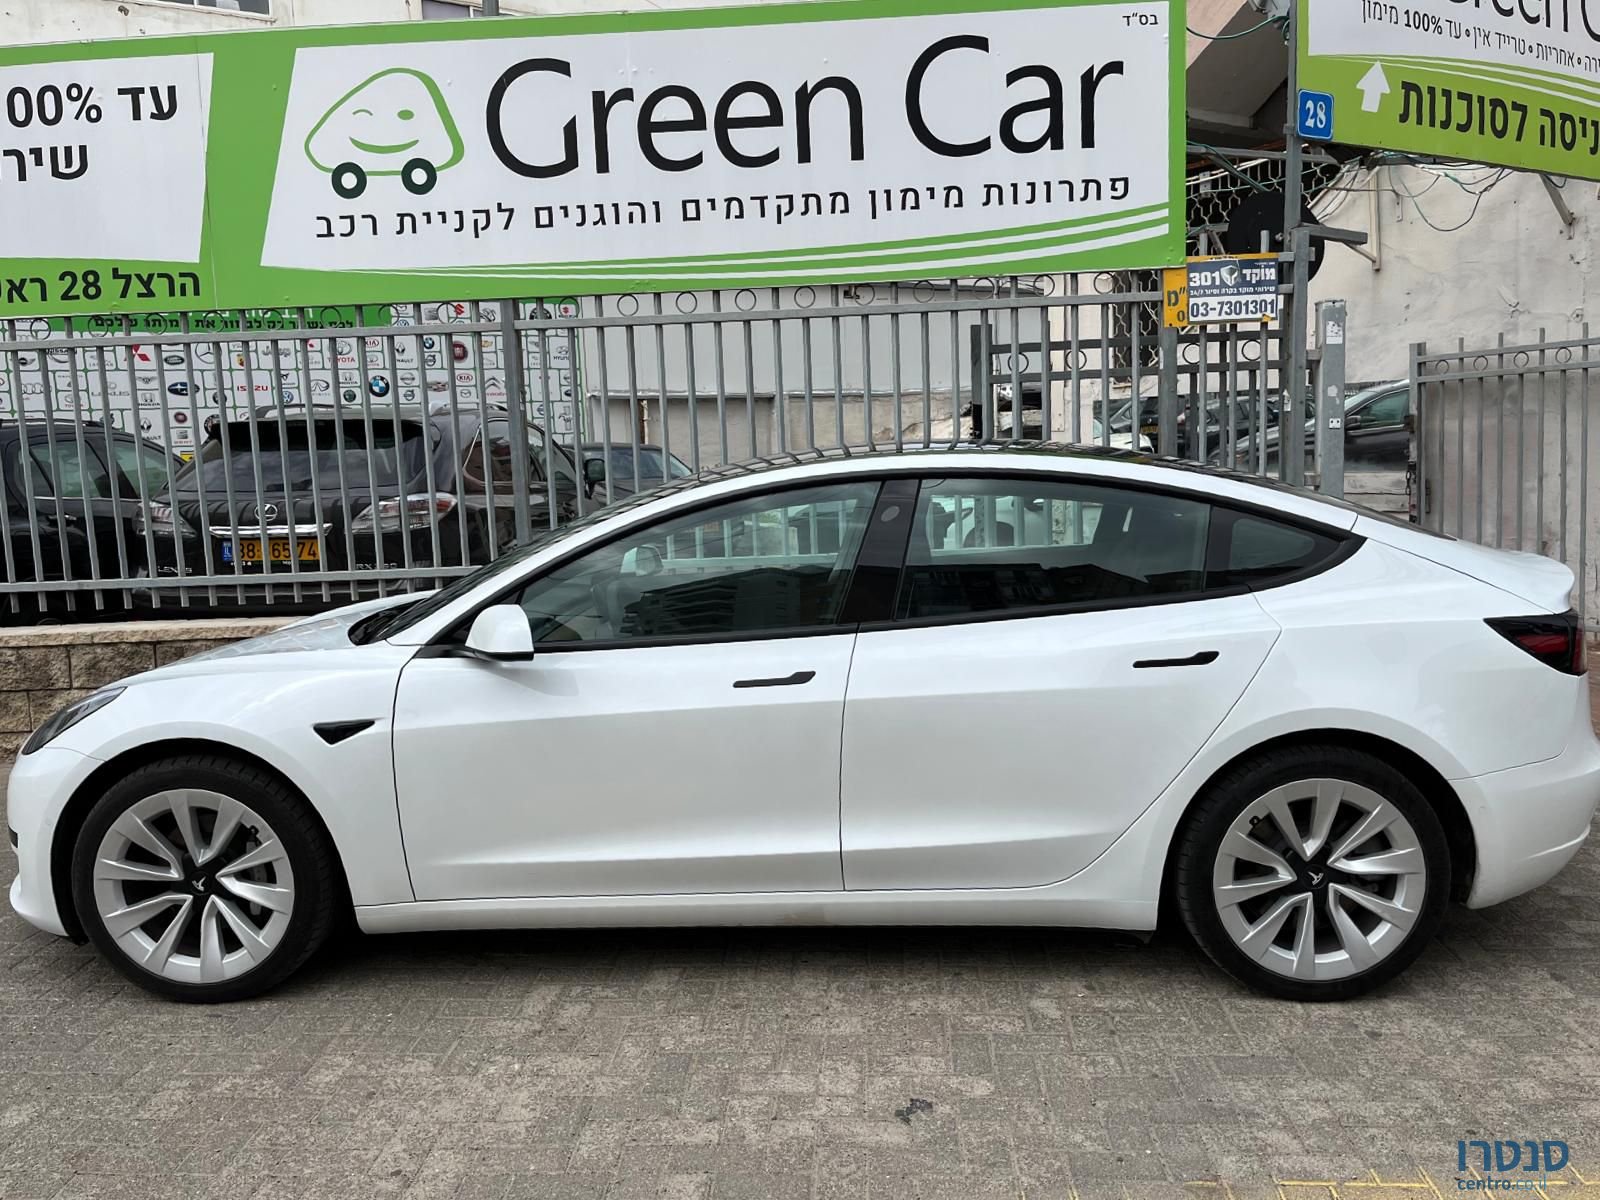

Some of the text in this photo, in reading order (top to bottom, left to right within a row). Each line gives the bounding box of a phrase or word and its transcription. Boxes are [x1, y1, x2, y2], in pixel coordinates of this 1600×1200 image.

[1122, 12, 1159, 27] בס"ד
[1362, 0, 1399, 25] מימון
[1403, 8, 1443, 35] 100%
[1445, 20, 1462, 40] עד
[1472, 26, 1491, 49] אין
[1495, 31, 1526, 56] טרייד
[1535, 42, 1575, 68] אחריות
[117, 85, 178, 121] עד
[486, 35, 1124, 179] Green Car
[1305, 100, 1327, 129] 28
[1398, 80, 1600, 156] ניסה לסוכנות
[316, 176, 1129, 239] פתרונות מימון מתקדמים והוגנים לקניית רכב
[0, 267, 201, 304] הרצל 28 רא
[1189, 270, 1221, 287] 301
[1190, 298, 1276, 319] 03-7301301
[327, 355, 356, 363] TYOTA
[157, 565, 193, 574] LEXS
